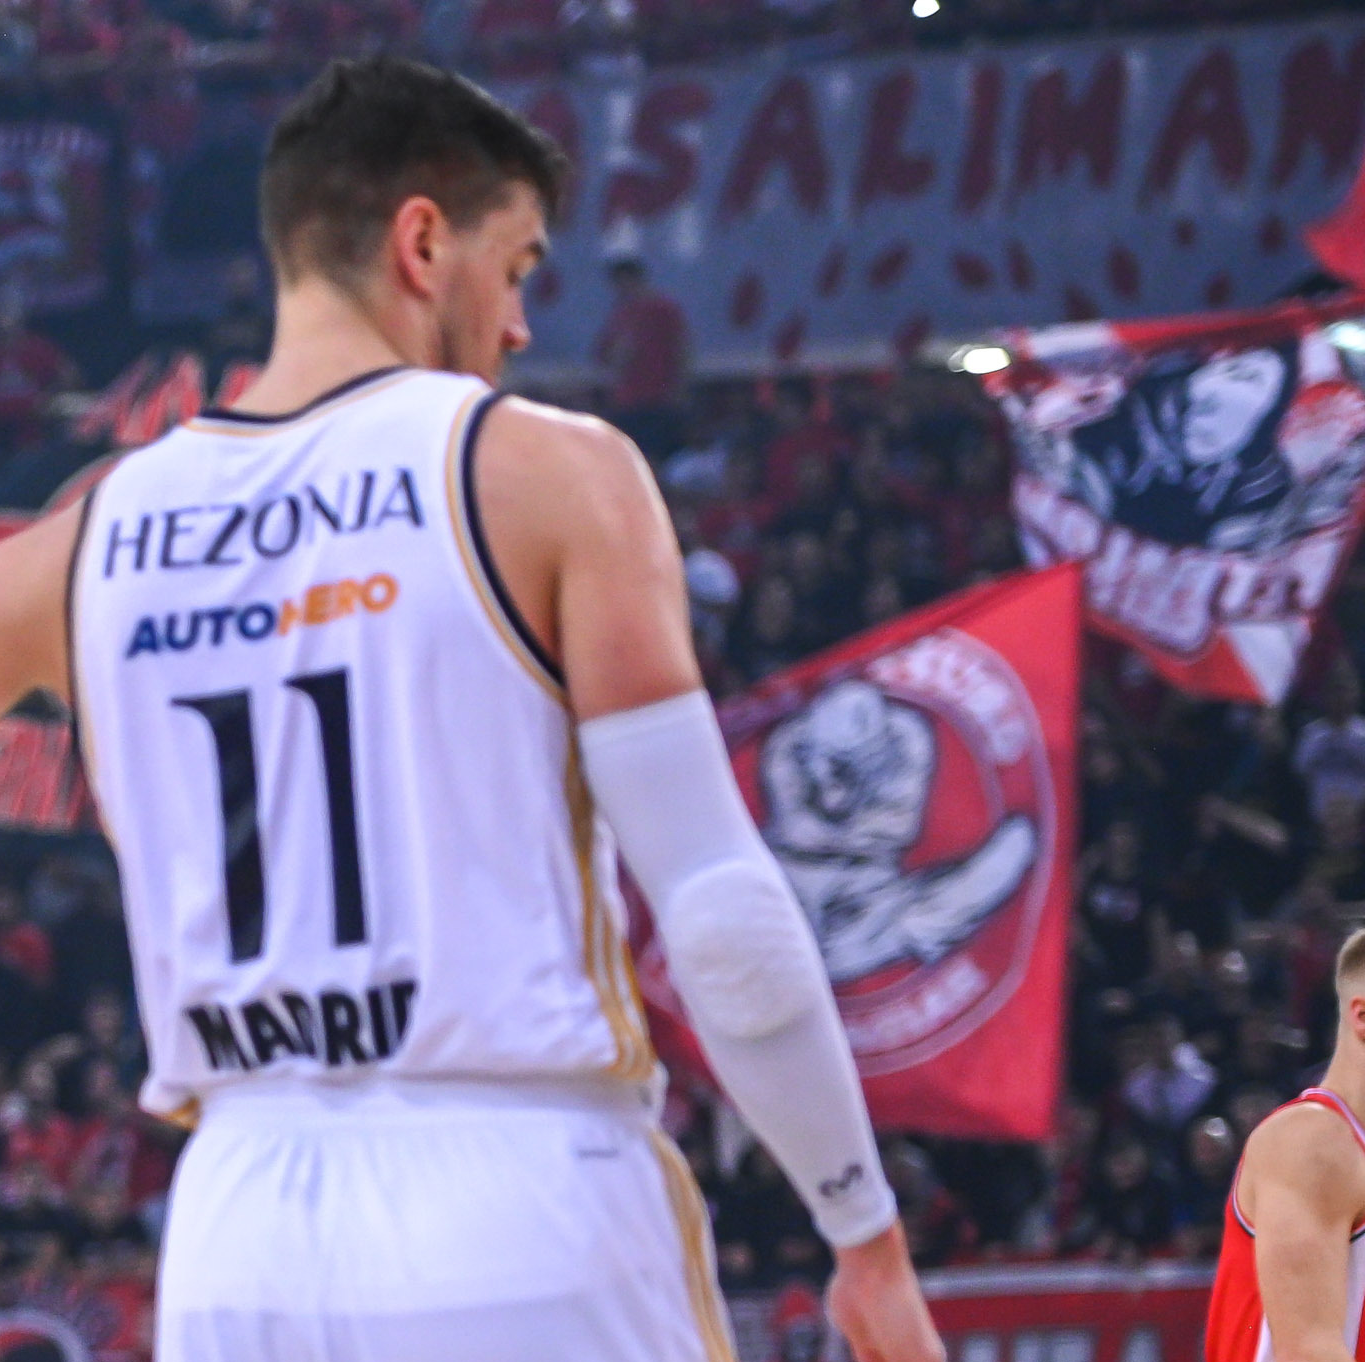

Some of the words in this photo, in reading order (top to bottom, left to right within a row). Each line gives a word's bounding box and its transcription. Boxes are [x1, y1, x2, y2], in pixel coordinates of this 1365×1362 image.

[103, 467, 426, 580] HEZONJA
[125, 574, 399, 660] AUTOHERO
[170, 667, 371, 966] 11
